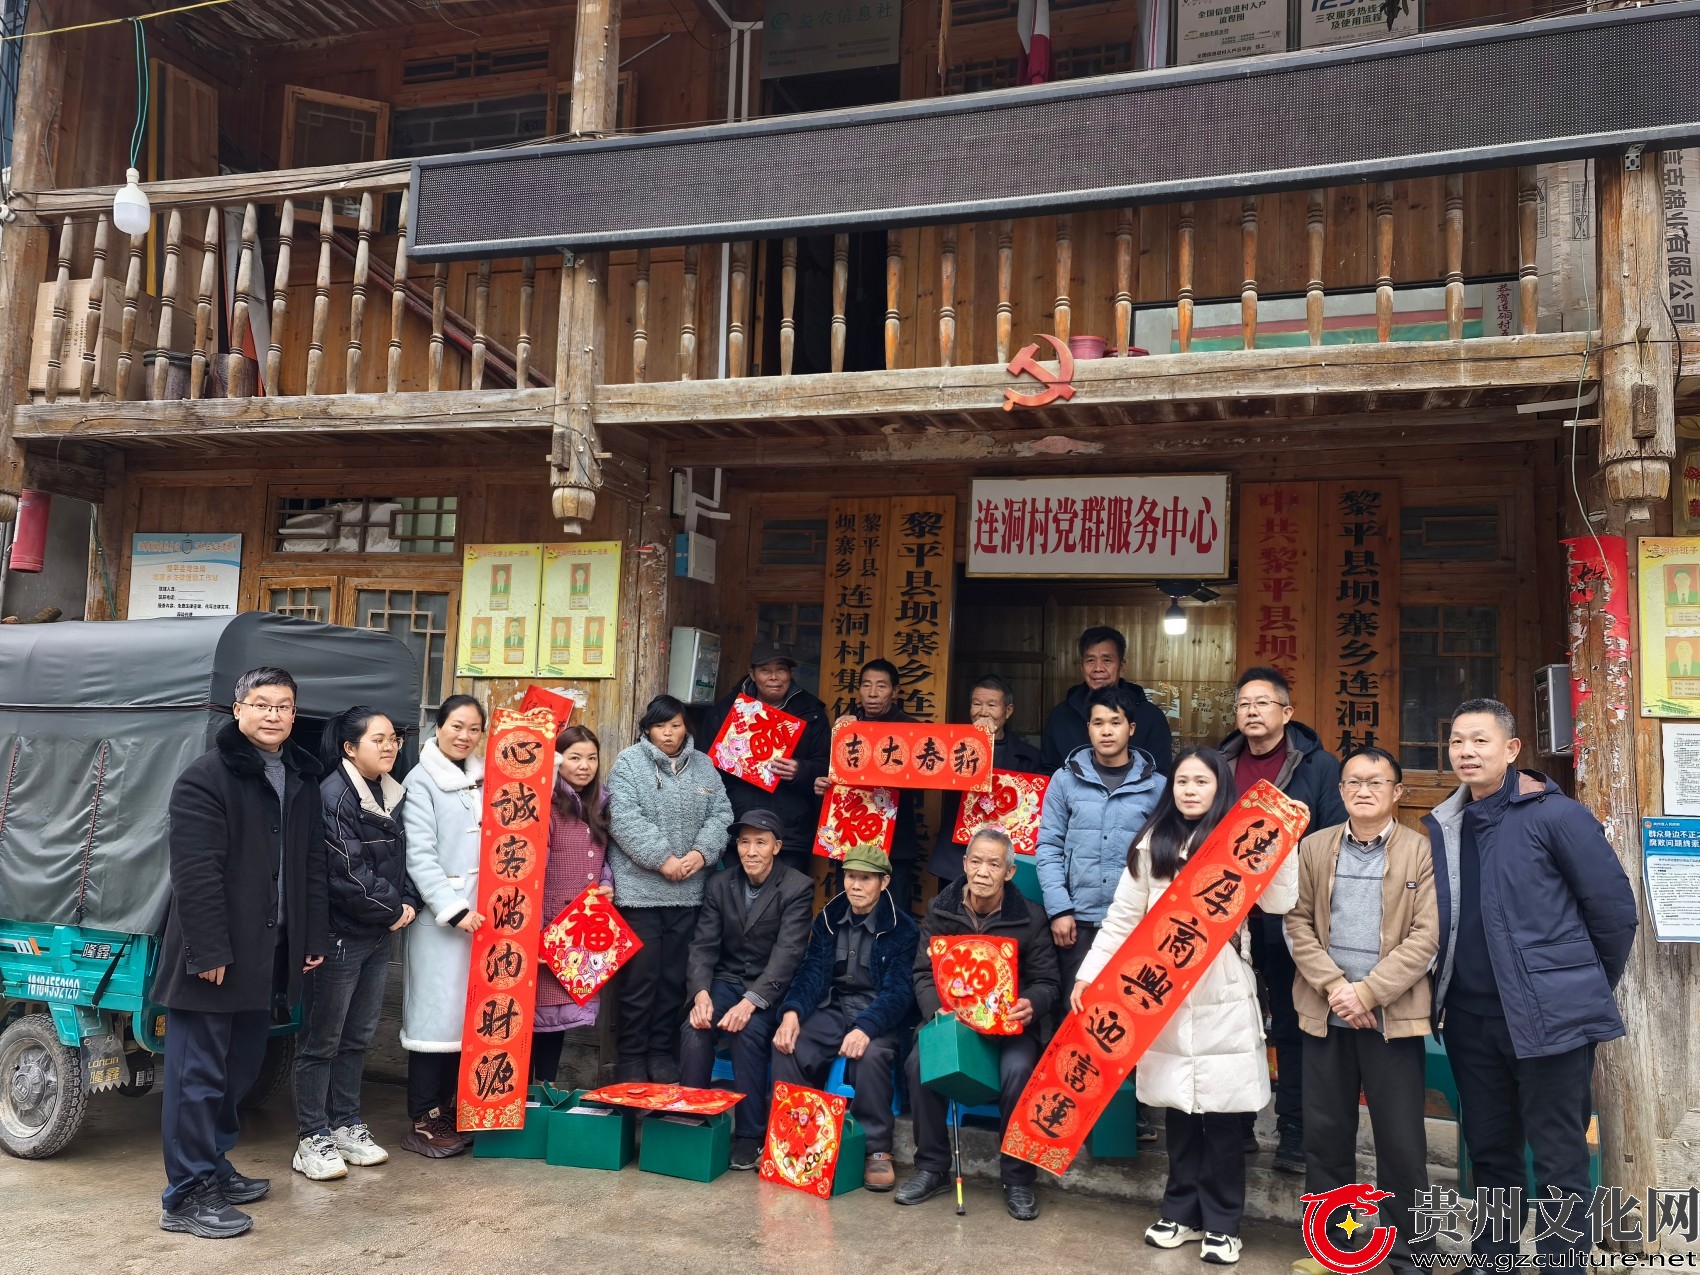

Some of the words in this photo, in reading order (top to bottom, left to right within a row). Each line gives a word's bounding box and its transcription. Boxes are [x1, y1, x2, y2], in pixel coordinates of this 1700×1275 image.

[799, 2, 893, 29] 益农信息社
[1197, 1, 1267, 19] 全国信息进村入户
[1219, 13, 1245, 25] 流程图
[1330, 13, 1383, 30] 及使用流程
[974, 495, 1218, 556] 连洞村党群服务中心
[834, 513, 856, 578] 坝寨乡
[859, 512, 882, 577] 黎平县
[834, 795, 883, 848] 福
[565, 902, 615, 953] 福
[82, 942, 111, 960] 隆鑫
[572, 986, 592, 994] smile
[90, 1067, 120, 1085] 隆鑫
